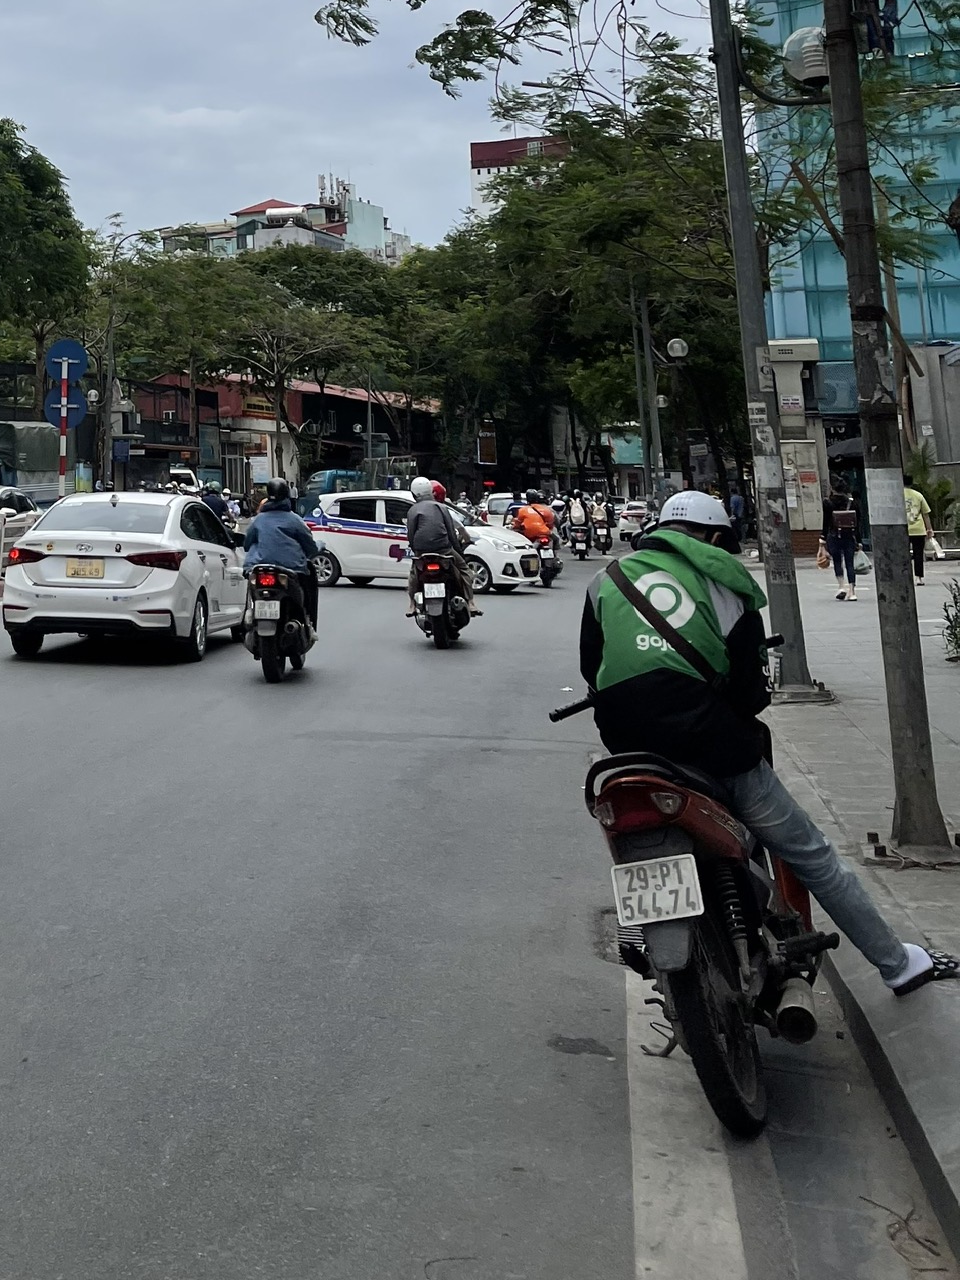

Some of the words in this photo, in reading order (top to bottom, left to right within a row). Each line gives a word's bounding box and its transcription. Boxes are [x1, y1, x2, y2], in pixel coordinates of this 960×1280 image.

[636, 634, 692, 652] goj
[624, 861, 683, 892] 29-P1
[622, 886, 697, 921] 544.74
